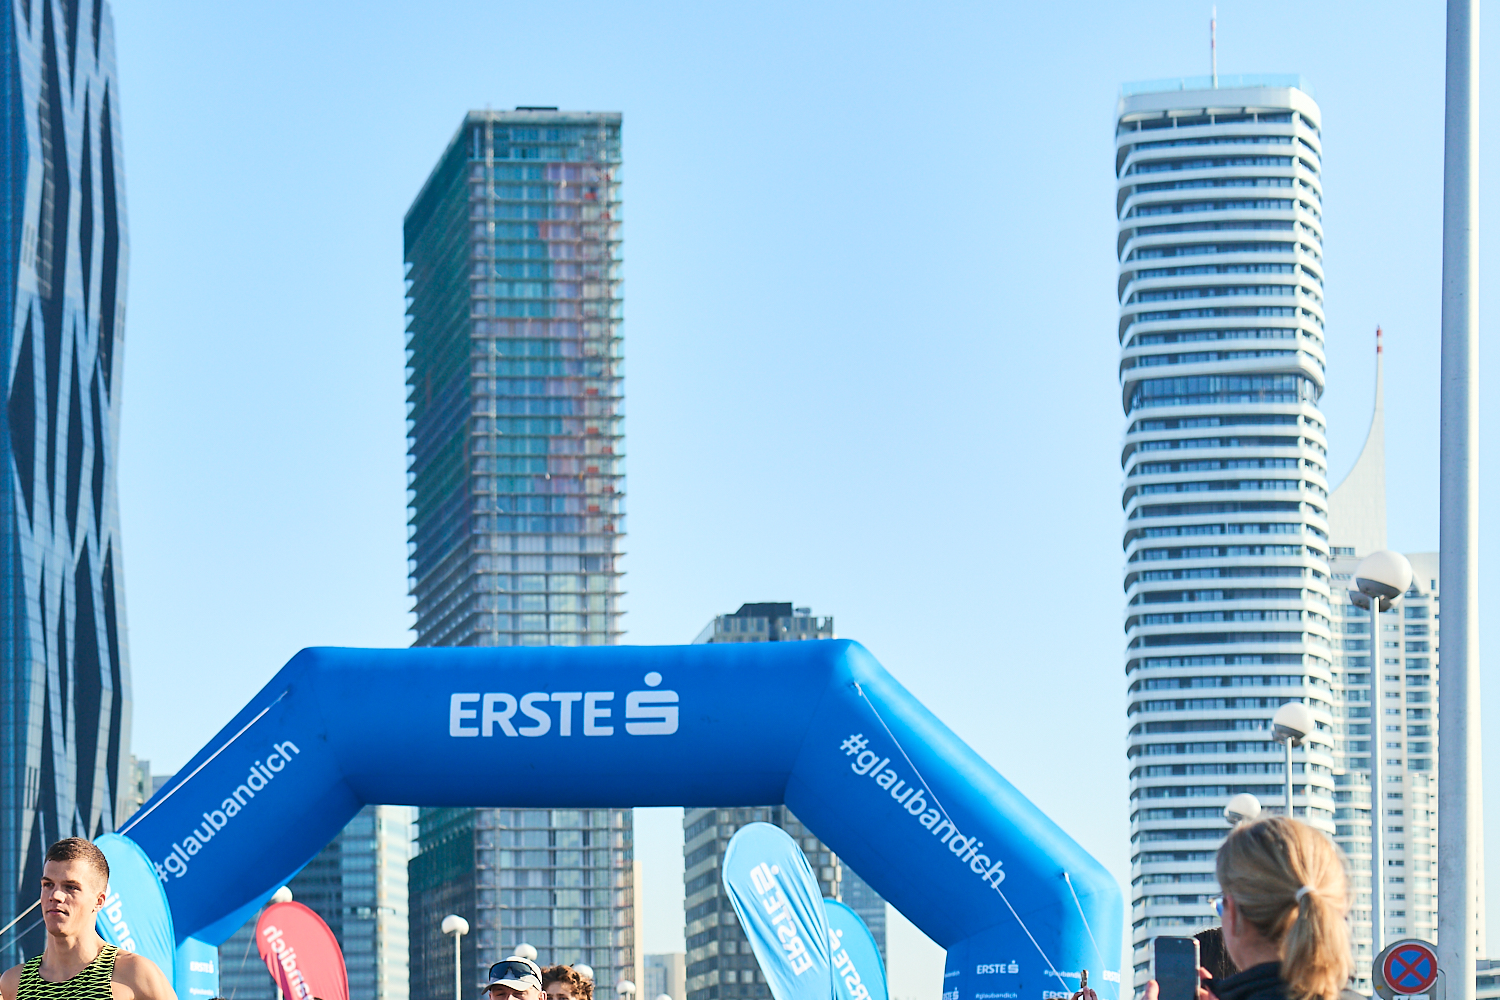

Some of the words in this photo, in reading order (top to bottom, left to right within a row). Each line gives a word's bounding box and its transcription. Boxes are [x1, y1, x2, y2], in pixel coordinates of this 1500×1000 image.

[449, 691, 615, 737] ERSTE
[154, 741, 300, 882] #glaubandich
[840, 734, 1006, 889] #glaubandich
[976, 963, 1006, 975] ERSTE
[975, 991, 1018, 1000] #glaubandich
